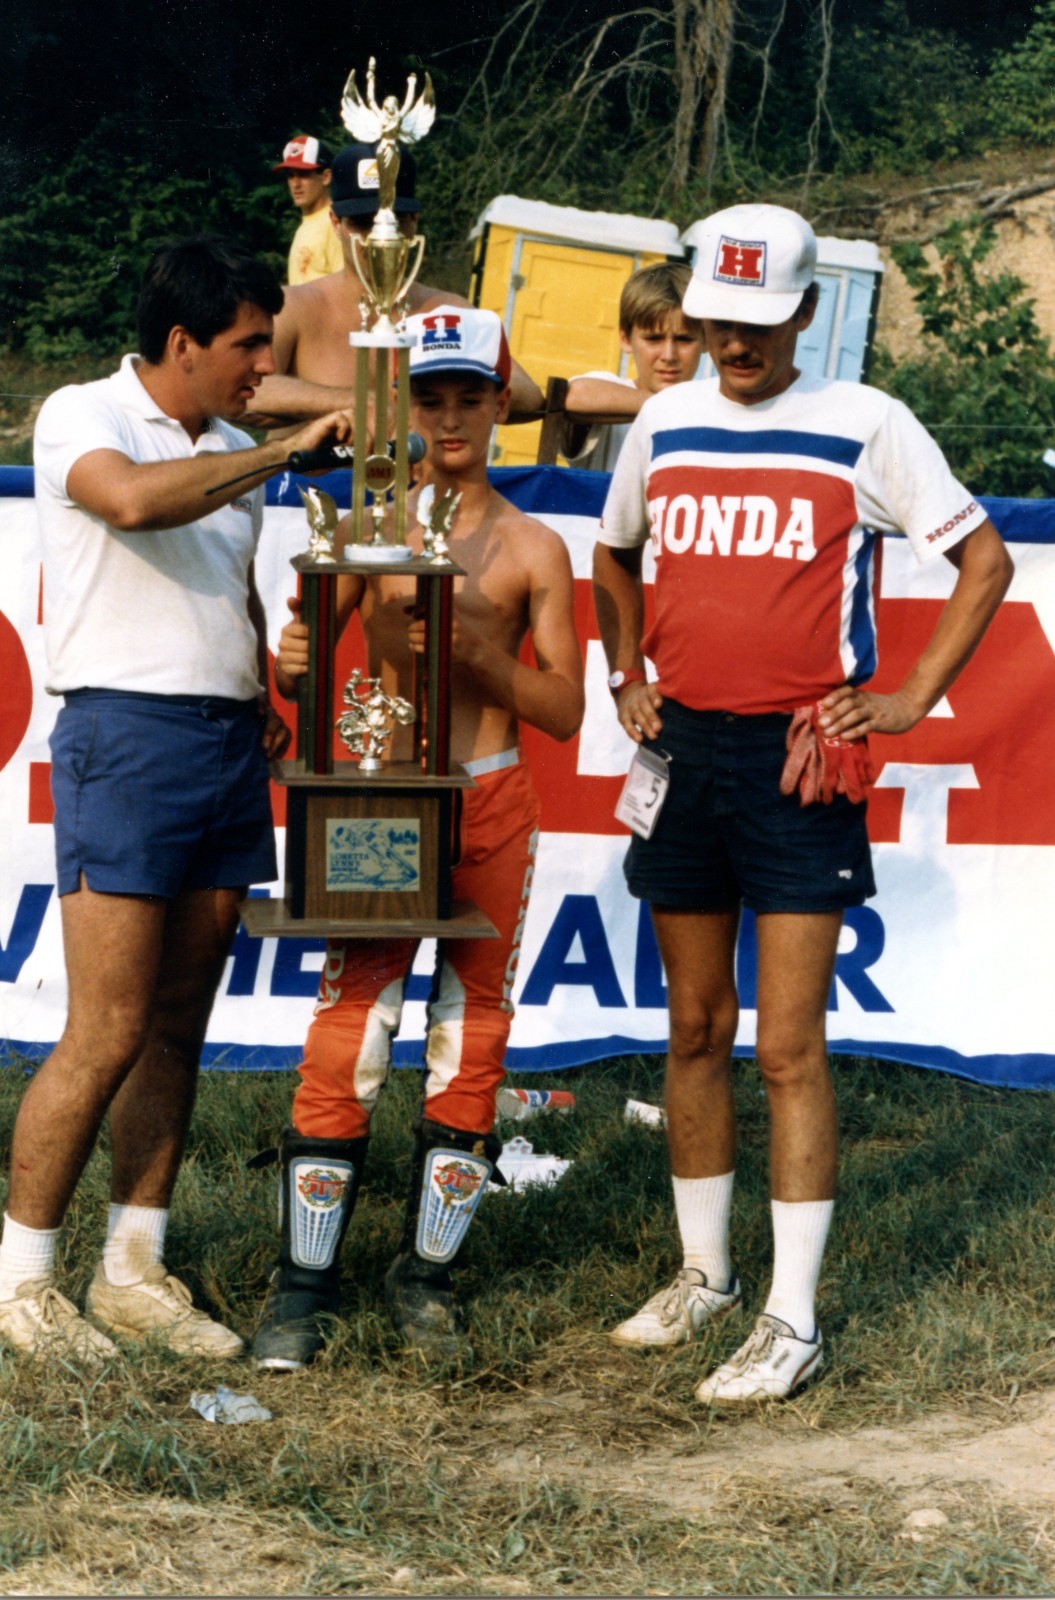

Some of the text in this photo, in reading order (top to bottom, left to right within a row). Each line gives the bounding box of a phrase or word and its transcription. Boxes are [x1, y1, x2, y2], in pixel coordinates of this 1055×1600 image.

[718, 243, 763, 279] H
[422, 343, 462, 353] HONDA
[925, 502, 979, 543] HOND
